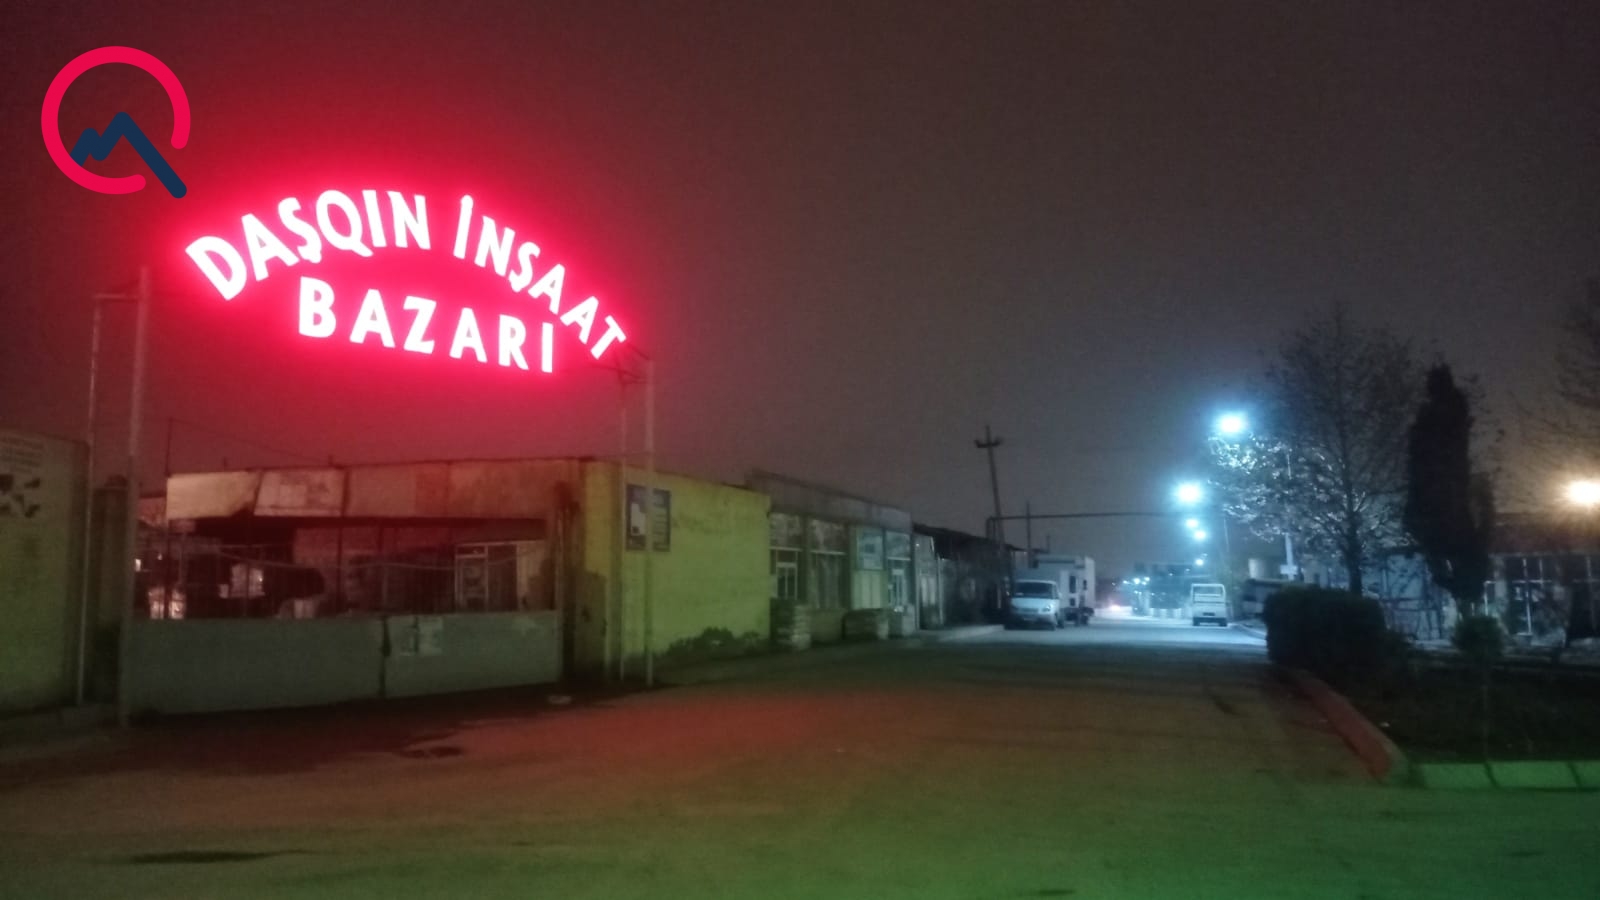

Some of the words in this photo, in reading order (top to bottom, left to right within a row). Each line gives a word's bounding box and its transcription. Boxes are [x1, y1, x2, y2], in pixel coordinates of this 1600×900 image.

[185, 189, 431, 300] DAŞQIN
[454, 194, 627, 360] İNŞAAT
[298, 276, 555, 373] BAZARI
